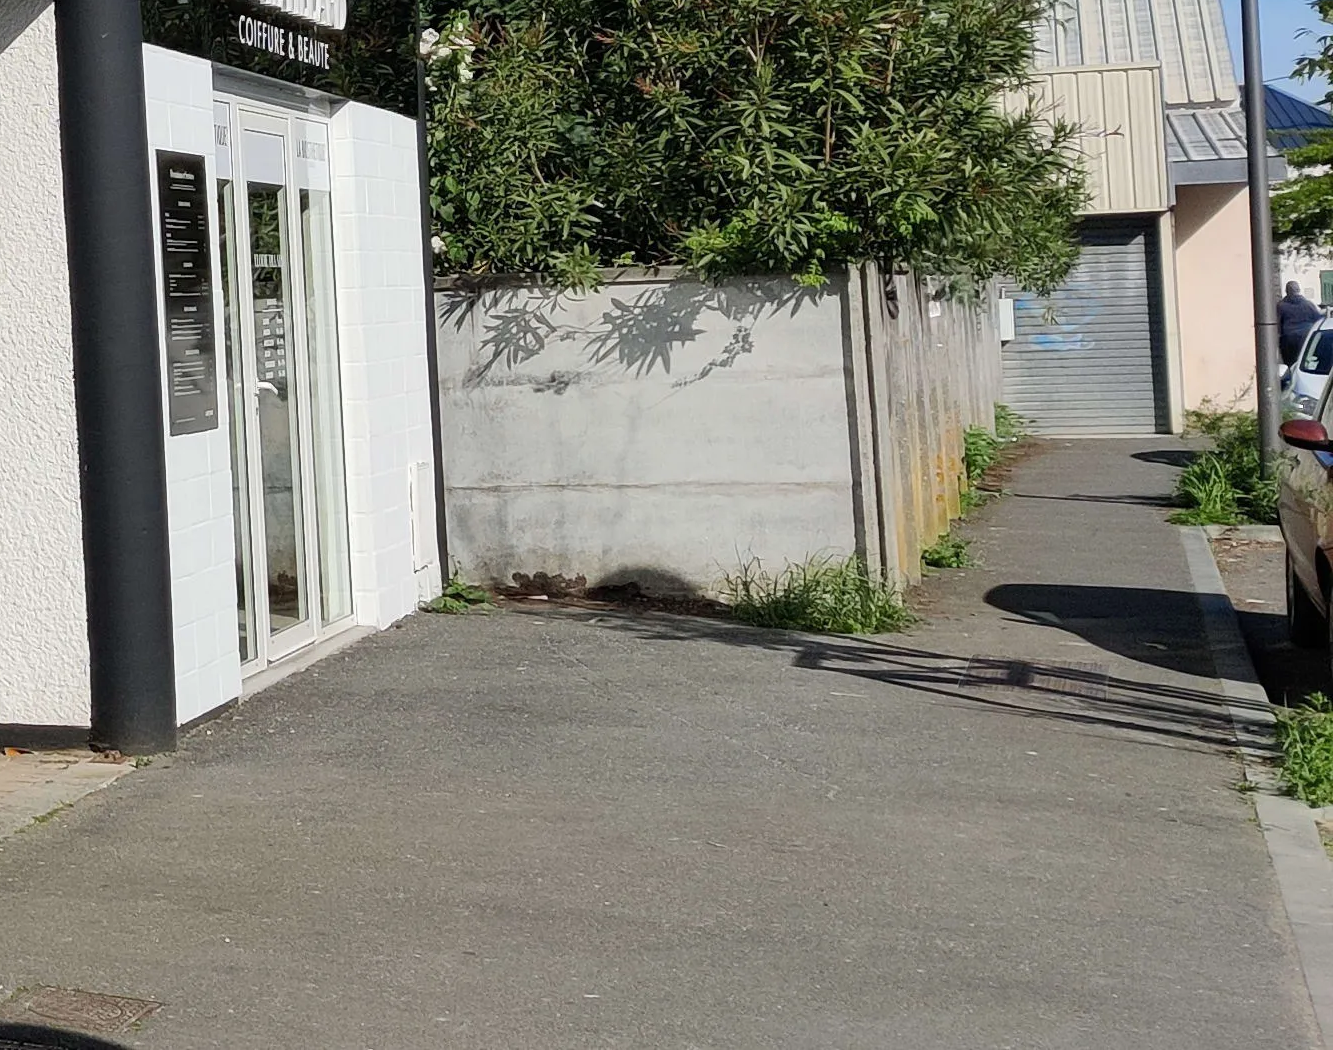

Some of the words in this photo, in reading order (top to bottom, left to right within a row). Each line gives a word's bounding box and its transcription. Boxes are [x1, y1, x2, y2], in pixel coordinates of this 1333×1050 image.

[238, 15, 286, 56] COIFFURE
[288, 31, 296, 60] &
[297, 34, 330, 70] BEAUTE
